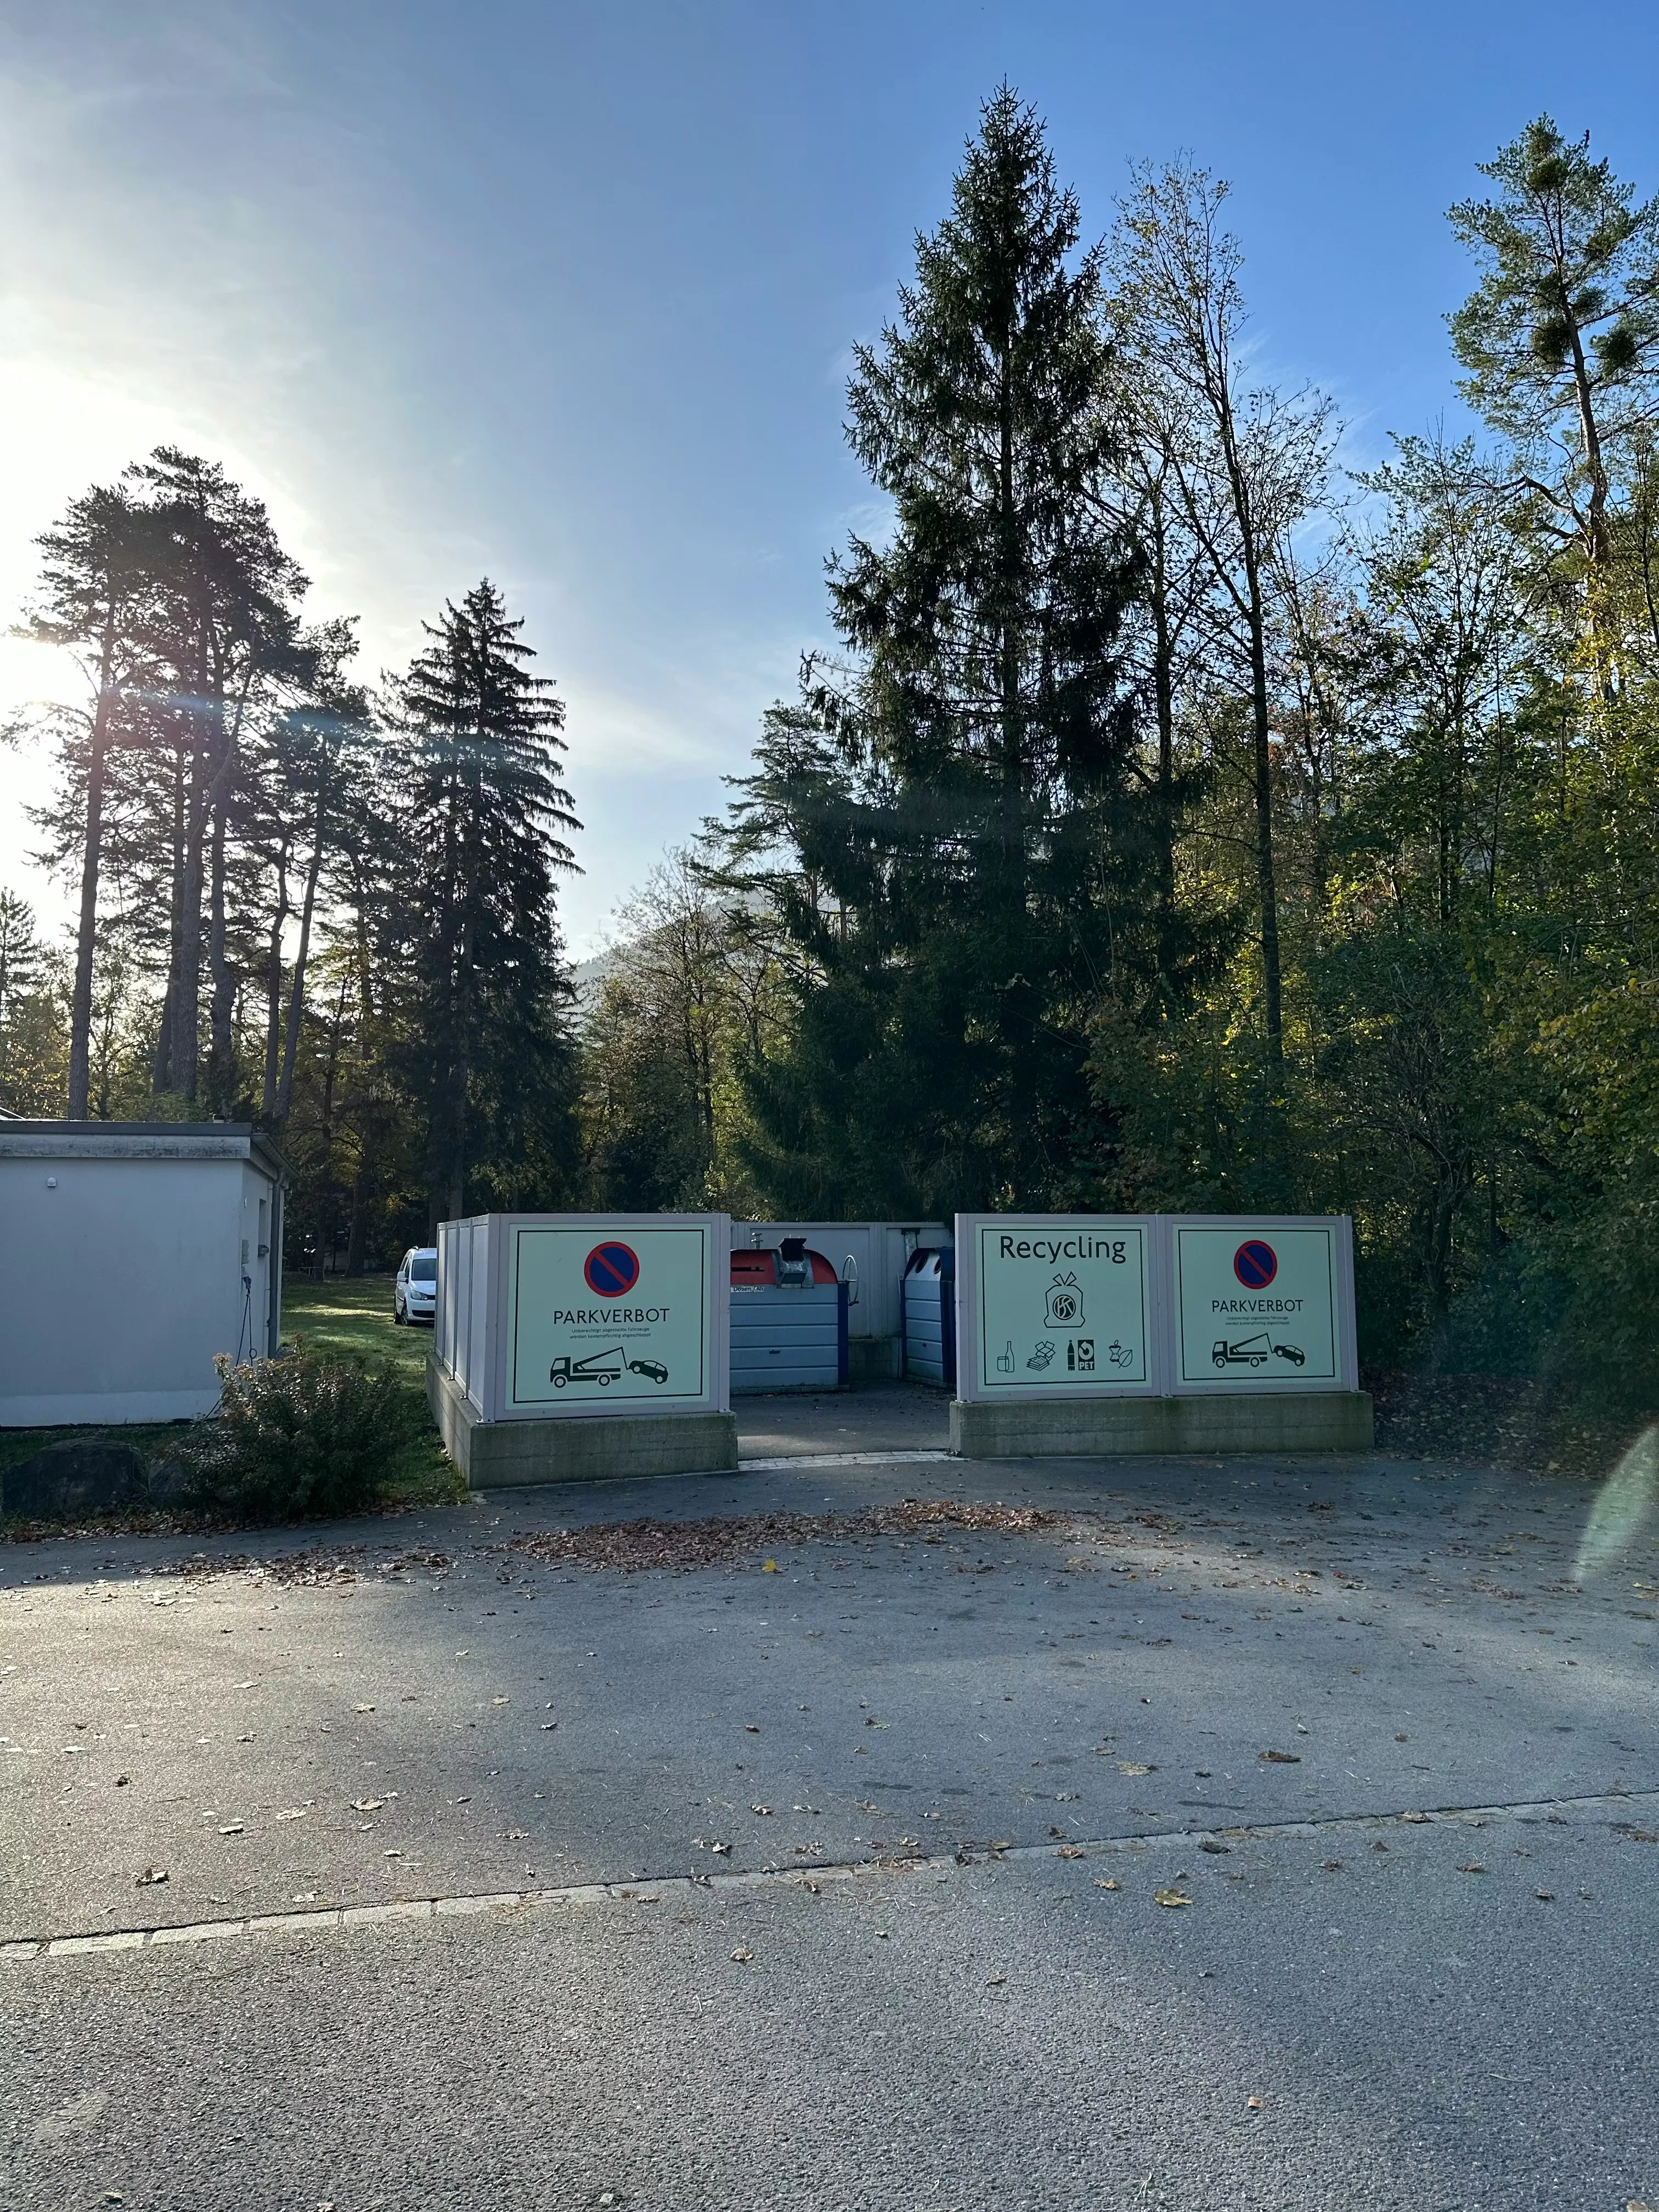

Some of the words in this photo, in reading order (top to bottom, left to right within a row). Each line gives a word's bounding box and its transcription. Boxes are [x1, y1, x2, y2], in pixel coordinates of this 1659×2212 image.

[1000, 1235, 1126, 1264] Recycling
[1212, 1300, 1304, 1312] PARKVERBOT
[554, 1308, 670, 1324] PARKVERBOT
[1079, 1361, 1094, 1370] PET
